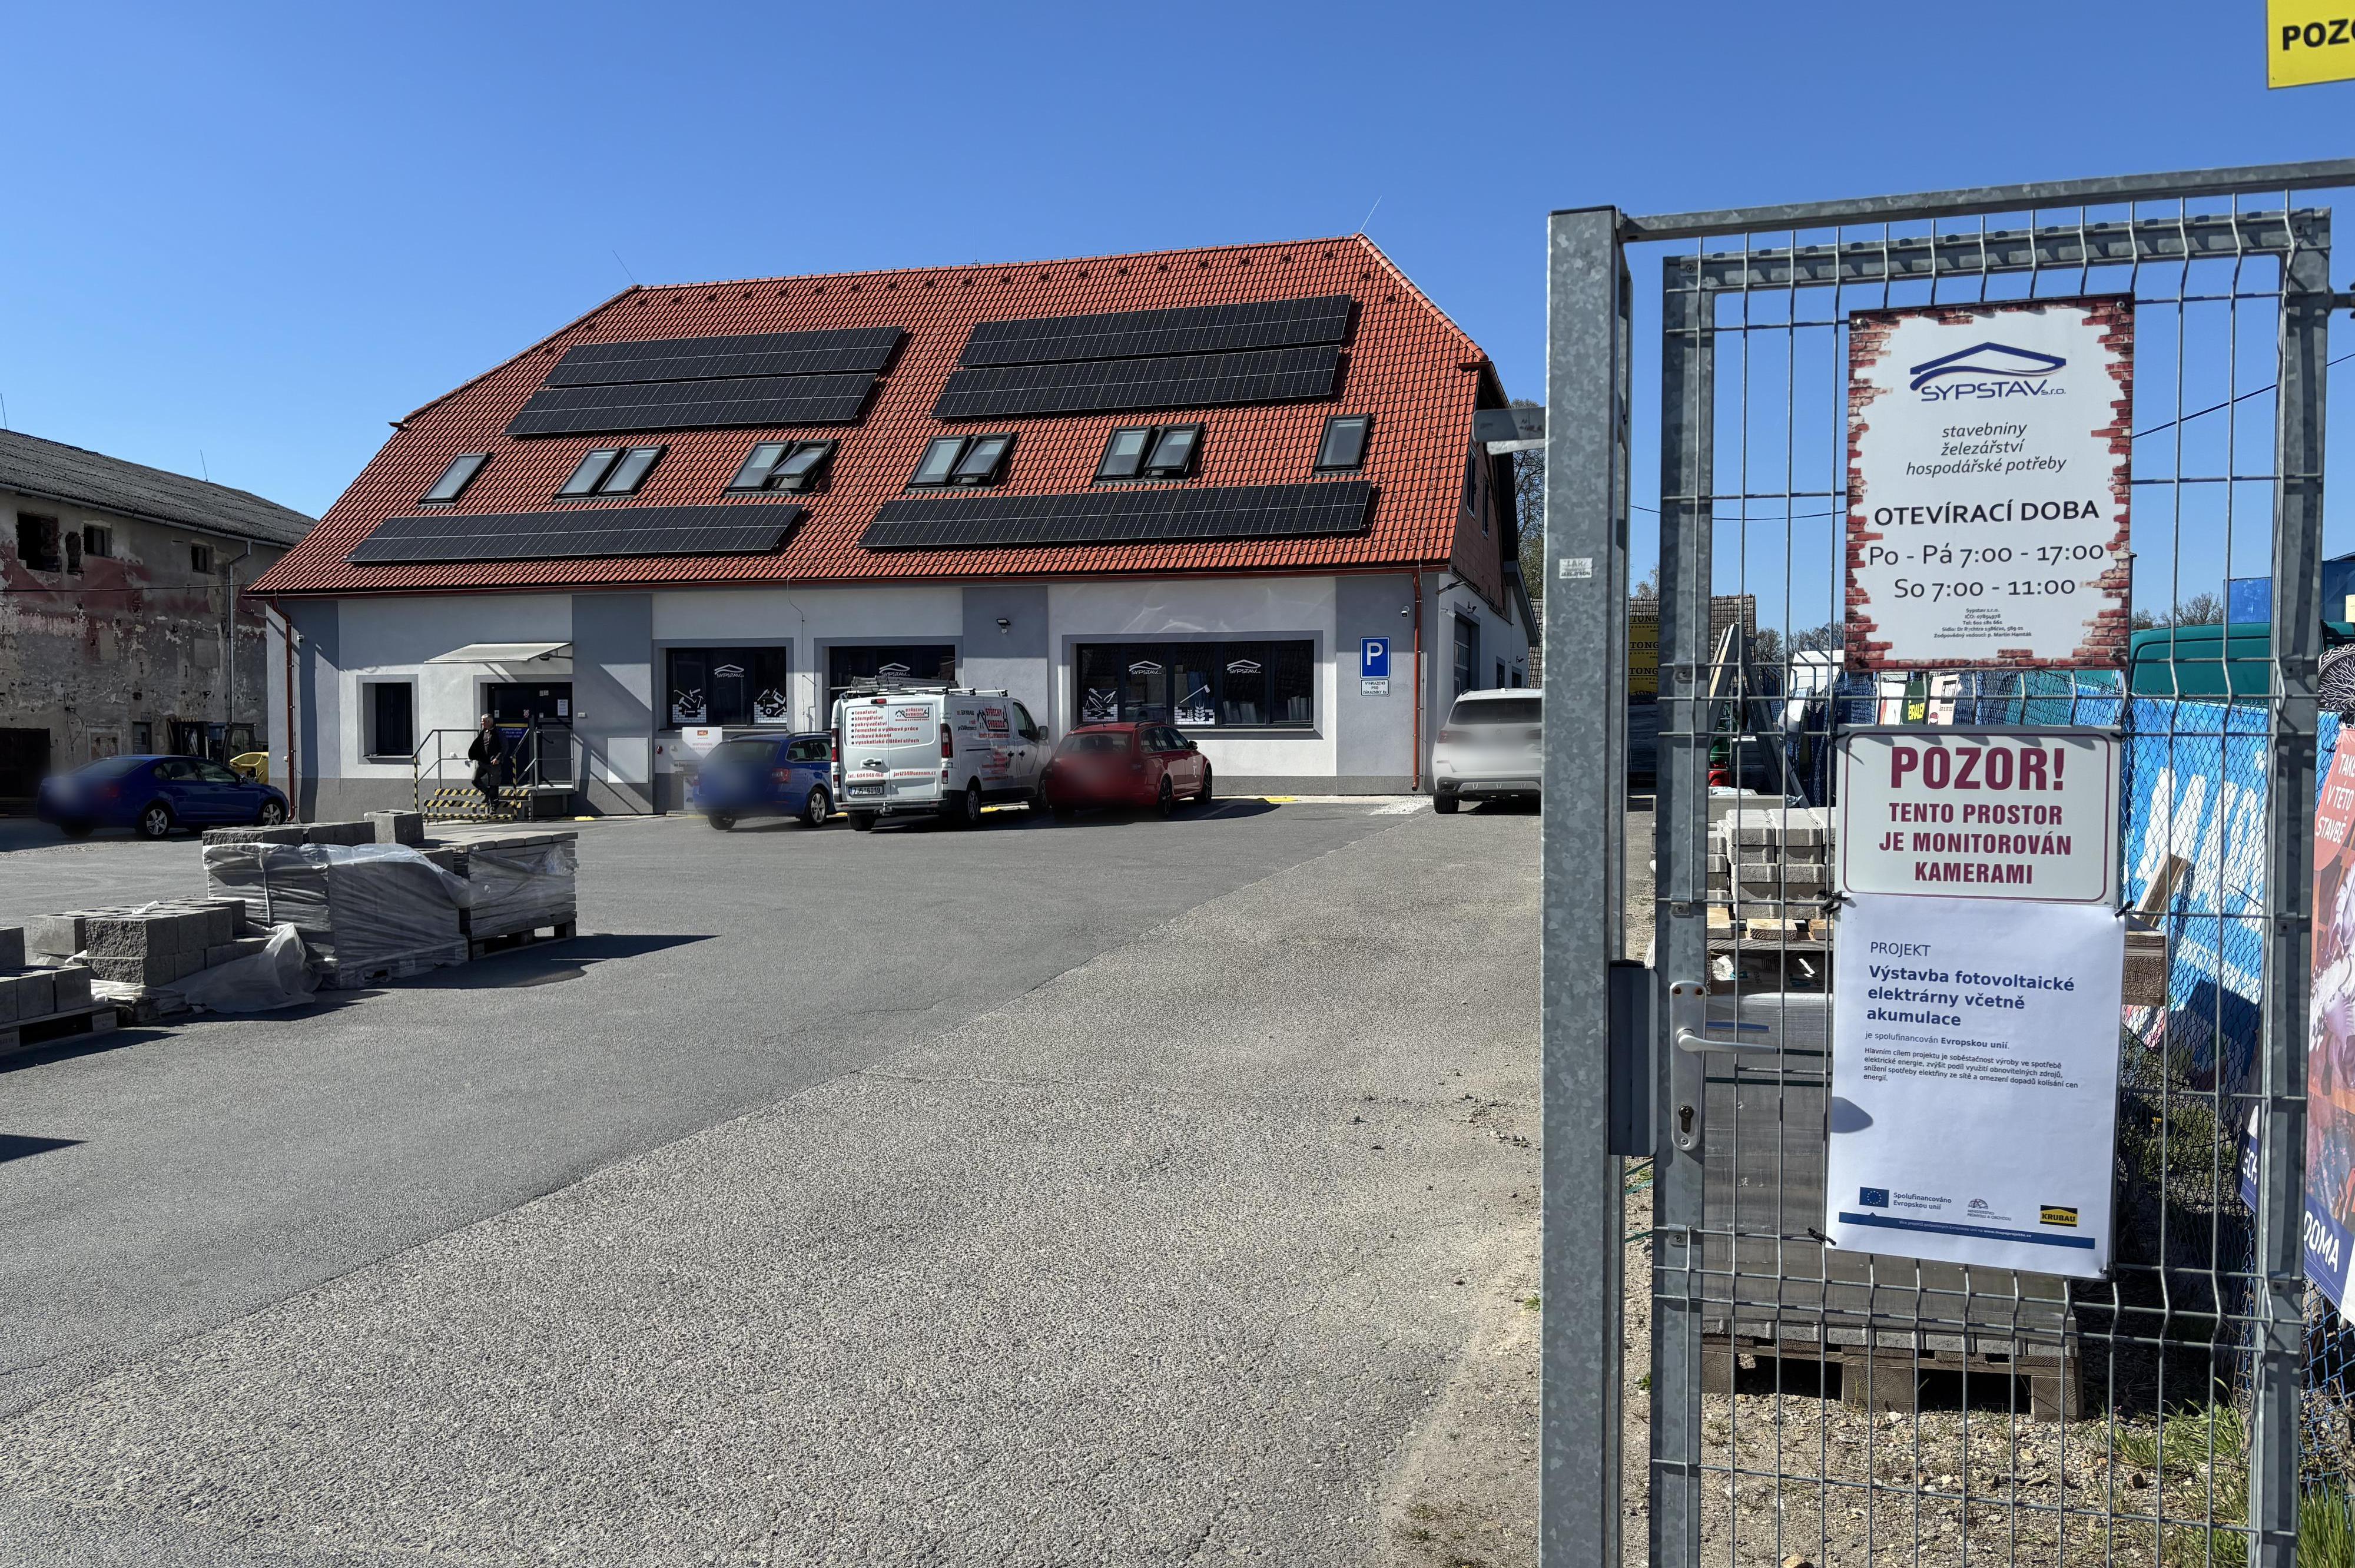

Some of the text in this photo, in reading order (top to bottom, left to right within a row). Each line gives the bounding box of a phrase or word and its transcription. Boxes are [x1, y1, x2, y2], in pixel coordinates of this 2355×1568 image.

[2283, 19, 2355, 51] POZ
[1921, 379, 2047, 402] SYPSTAV
[1942, 422, 2028, 438] stavebniny
[1941, 438, 2026, 456] železářství
[1906, 456, 2067, 478] hospodářské potřeby
[1874, 499, 2100, 526] OTEVÍRACÍ DOBA
[1869, 546, 1899, 566] Po
[1923, 542, 1953, 564] Pá
[1959, 548, 2012, 568] 7:00
[2036, 545, 2104, 566] 17:00
[1894, 578, 1925, 598] So
[1932, 582, 1984, 602] 7:00
[2008, 579, 2075, 596] 11:00
[1366, 642, 1384, 666] P
[1890, 747, 2065, 791] POZOR!
[2326, 780, 2354, 811] V TÉTO
[1889, 803, 2062, 825] TENTO PROSTOR
[2315, 814, 2348, 844] STAVBĚ
[1879, 830, 2072, 855] JE MONITOROVÁN
[1915, 862, 2033, 884] KAMERAMI
[1870, 942, 1931, 957] PROJEKT
[1869, 964, 2075, 992] Výstavba fotovoltaické
[1868, 986, 2025, 1009] elektrárny včetně
[1867, 1007, 1962, 1026] akumulace
[1865, 1031, 2010, 1049] je spolufinancován Evropskou unií.
[1864, 1056, 1896, 1065] elektrické
[1926, 1060, 1946, 1069] zvýšit
[1989, 1066, 2038, 1077] obnovitelných
[2039, 1070, 2063, 1079] zdrojů,
[1865, 1047, 1891, 1055] Hlavním
[1912, 1051, 1940, 1060] projektu
[1949, 1053, 1994, 1063] soběstačnost
[1995, 1058, 2019, 1067] výroby
[2031, 1060, 2062, 1070] spotřebě
[1863, 1065, 1887, 1073] snížení
[1888, 1067, 1917, 1076] spotřeby
[1918, 1069, 1948, 1079] elektřiny
[1979, 1075, 2009, 1083] omezení
[2009, 1077, 2036, 1085] dopadů
[2037, 1079, 2064, 1088] kolísání
[1863, 1073, 1888, 1082] energií.
[1893, 1192, 1952, 1204] Spolufinancováno
[1893, 1200, 1927, 1209] Evropskou
[2042, 1213, 2075, 1222] KRUBAU
[2303, 1210, 2339, 1272] DOMA
